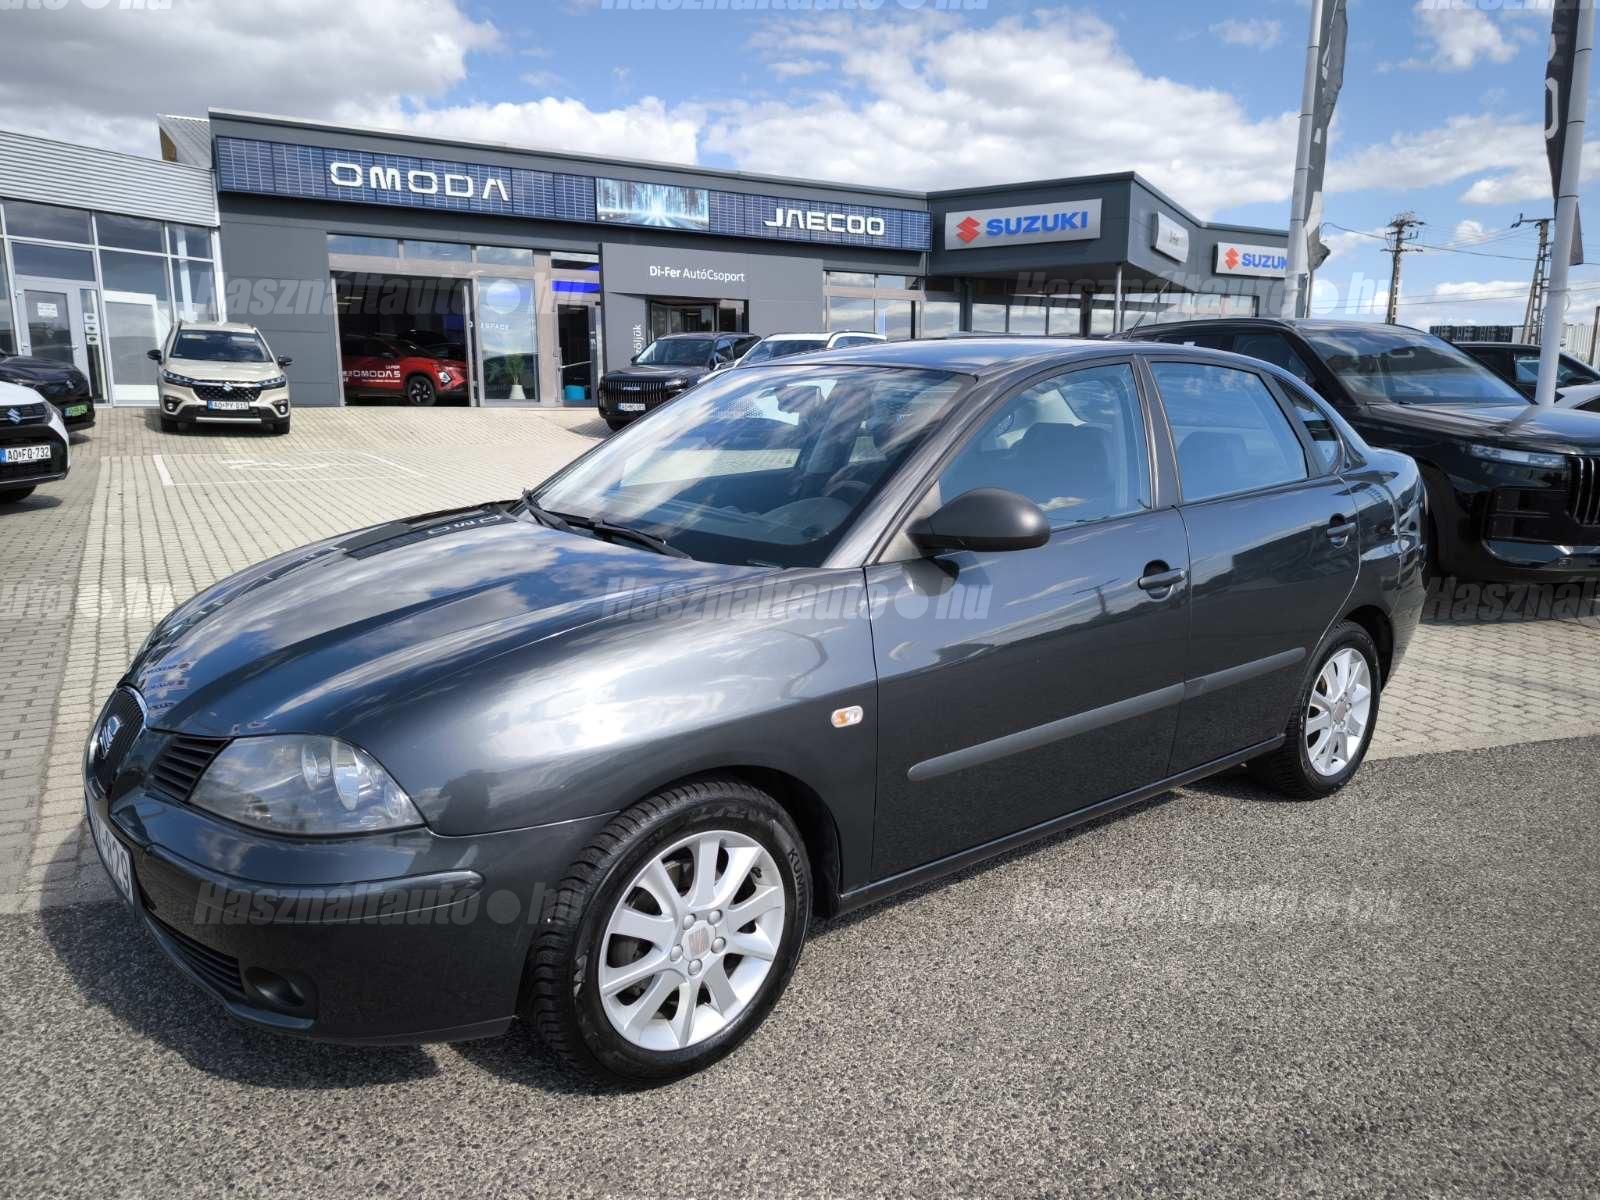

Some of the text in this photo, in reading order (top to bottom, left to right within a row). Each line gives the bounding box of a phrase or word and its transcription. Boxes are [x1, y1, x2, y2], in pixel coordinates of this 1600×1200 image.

[330, 162, 509, 201] OMODA
[763, 207, 885, 236] JAECOO
[985, 210, 1089, 237] SUZUKI
[649, 265, 745, 283] Di-Fer AutóCsoport
